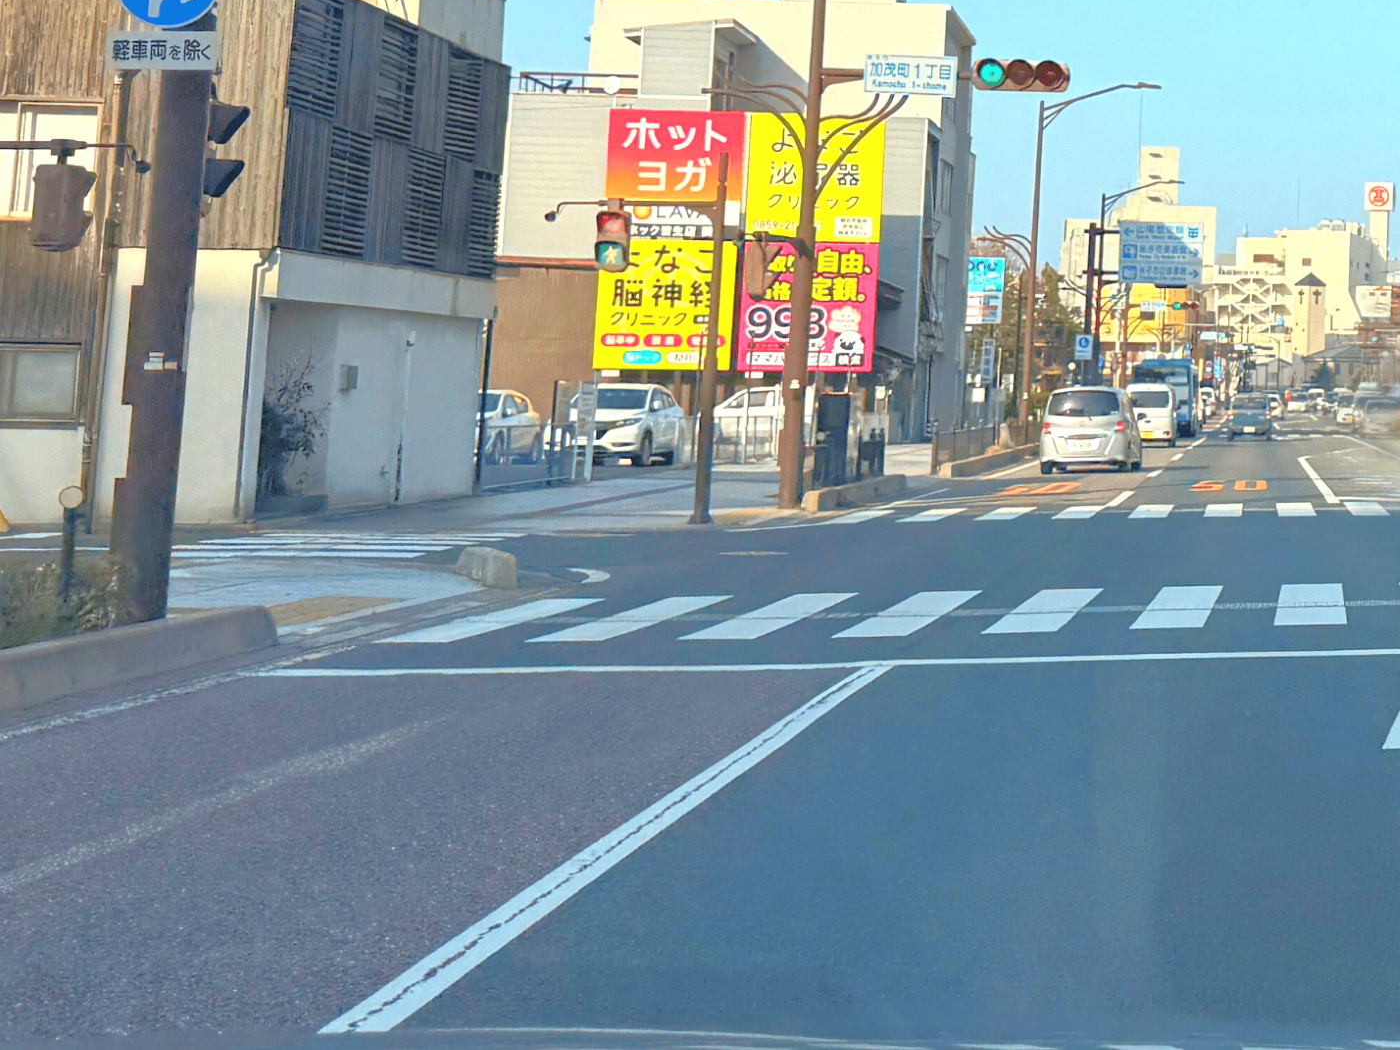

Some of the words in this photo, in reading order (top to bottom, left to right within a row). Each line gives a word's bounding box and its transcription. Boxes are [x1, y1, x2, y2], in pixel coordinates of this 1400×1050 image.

[112, 39, 211, 61] 軽車両を除く
[622, 117, 728, 151] ホット
[771, 128, 863, 153] よご
[637, 157, 712, 192] ヨガ
[656, 206, 701, 219] LAV
[768, 193, 860, 210] クリック
[611, 278, 711, 308] 脳神経
[610, 312, 688, 327] クリニック
